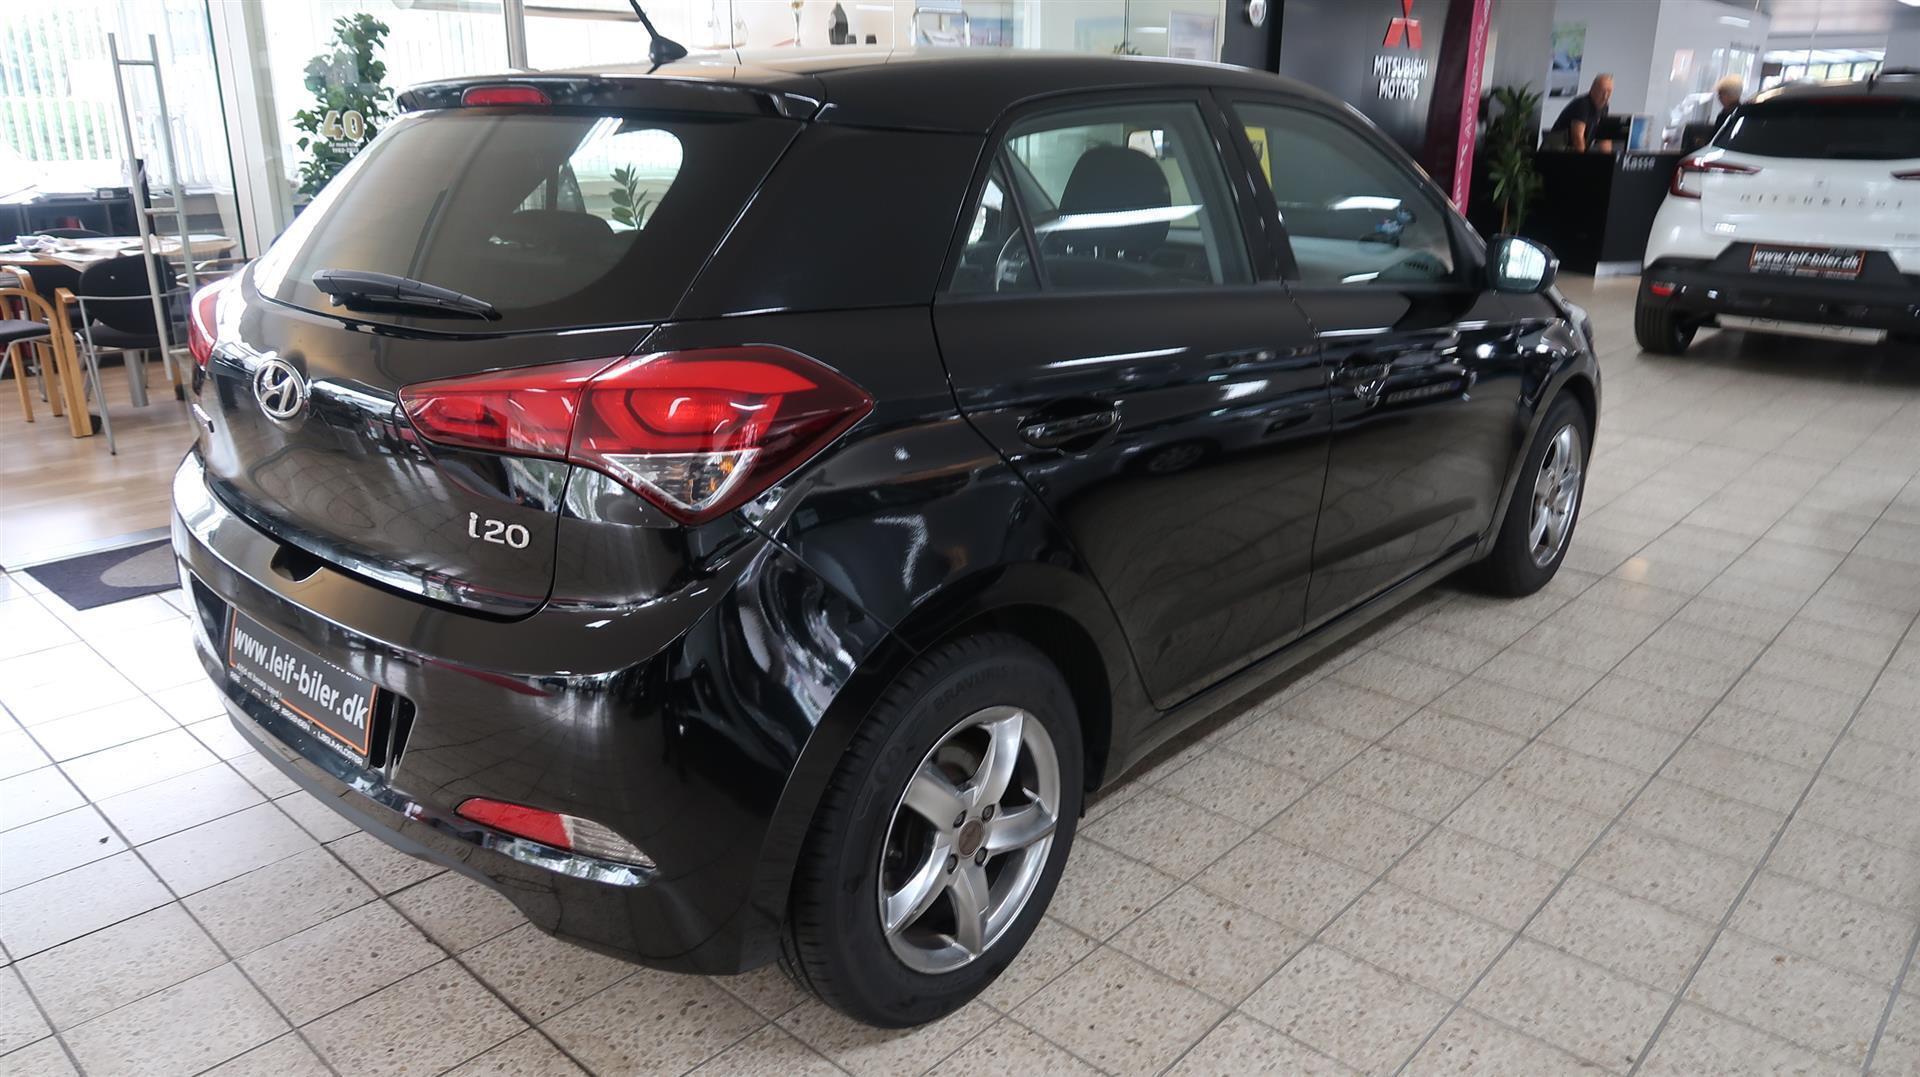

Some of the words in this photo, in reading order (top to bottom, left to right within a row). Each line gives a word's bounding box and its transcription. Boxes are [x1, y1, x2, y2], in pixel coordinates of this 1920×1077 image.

[1373, 55, 1429, 79] MITSUBISHI
[1378, 78, 1420, 100] MOTORS
[322, 110, 365, 141] 40
[1622, 153, 1656, 171] Kasse
[1753, 249, 1861, 270] www.leif-biler.dk
[468, 511, 530, 549] i20
[233, 627, 369, 730] www.leif-biler.dk
